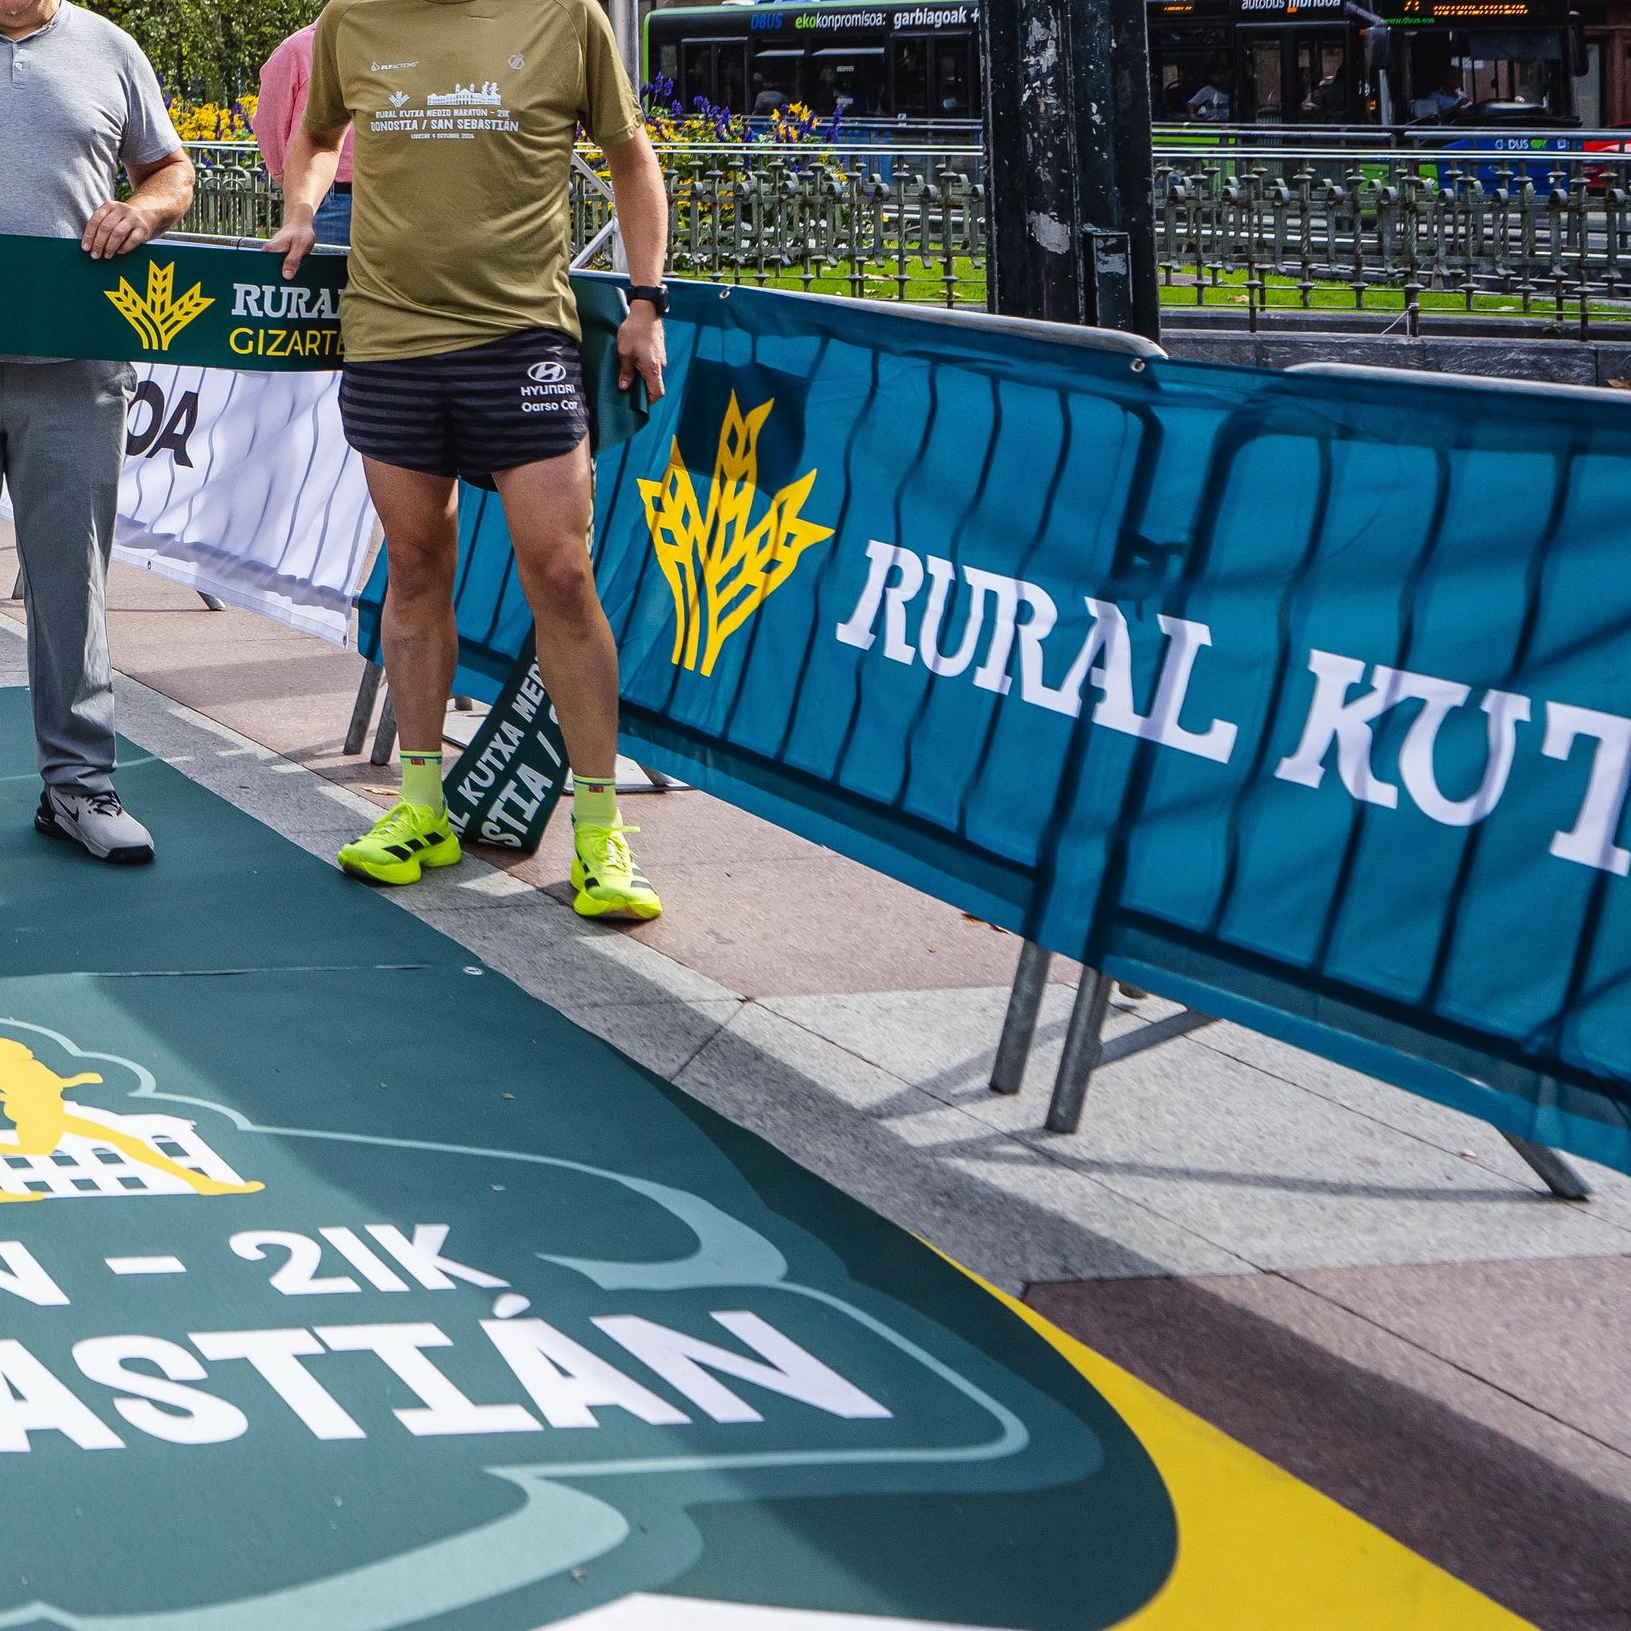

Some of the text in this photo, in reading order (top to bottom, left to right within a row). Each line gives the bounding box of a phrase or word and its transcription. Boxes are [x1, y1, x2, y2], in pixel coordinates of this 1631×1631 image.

[893, 5, 968, 29] garbiagoak
[370, 119, 418, 132] DONOSTIA
[430, 119, 454, 130] SAN
[456, 117, 520, 132] SEBASTIÁN
[375, 109, 398, 118] RURAL
[399, 109, 425, 118] KUTXA
[426, 109, 452, 117] MEDIO
[520, 383, 576, 396] HYUNDAI
[521, 399, 578, 412] Oarso Car
[835, 538, 1239, 765] RURAL
[457, 720, 525, 807] KUTXA
[477, 762, 555, 849] STIA
[227, 1222, 532, 1320] 21K
